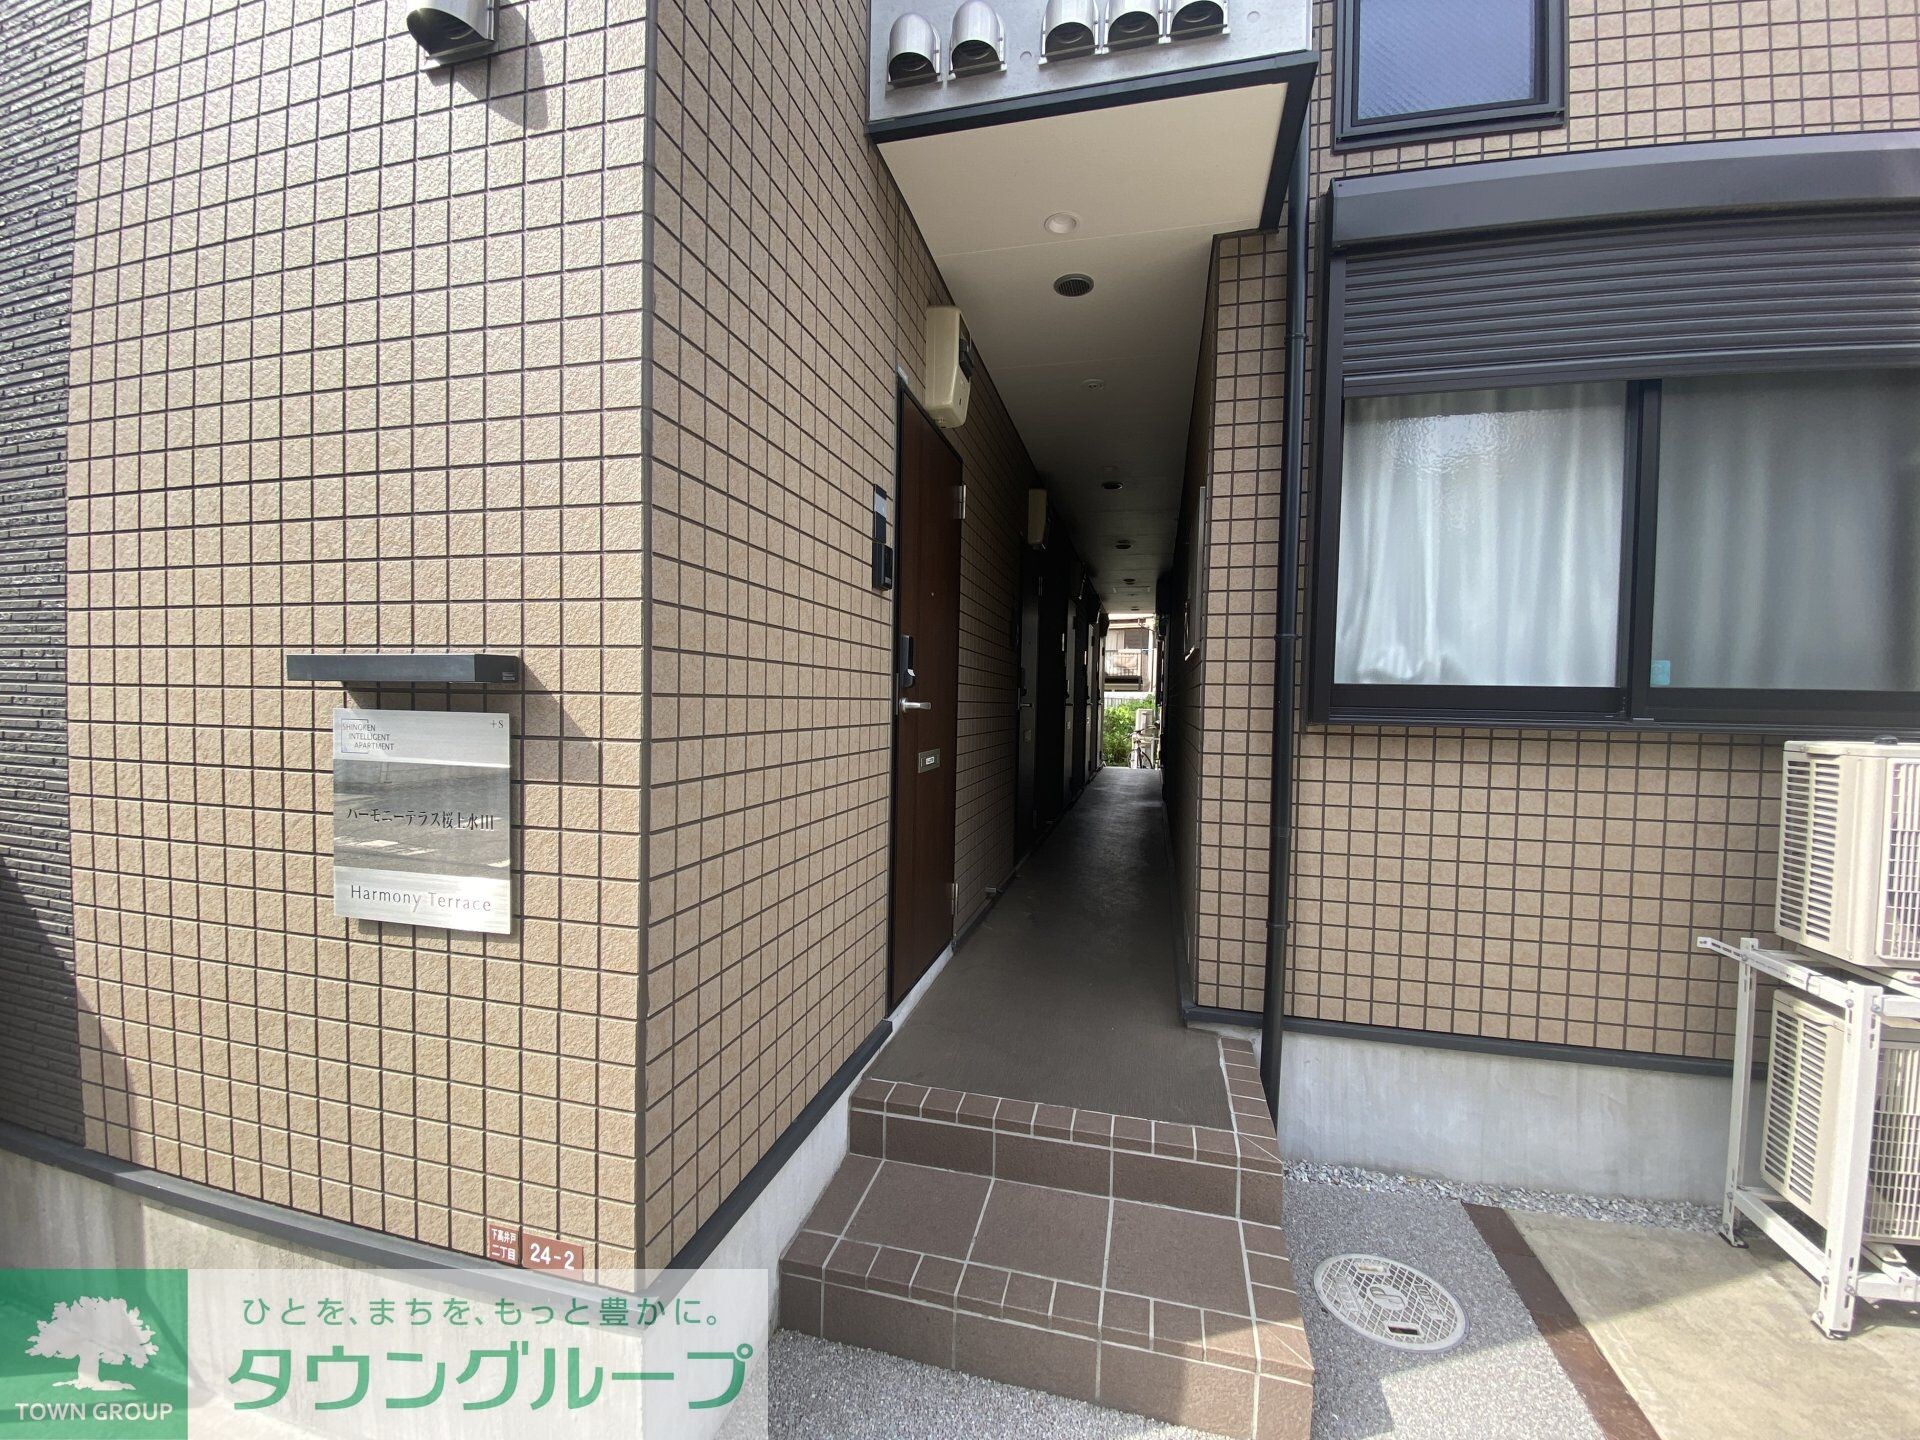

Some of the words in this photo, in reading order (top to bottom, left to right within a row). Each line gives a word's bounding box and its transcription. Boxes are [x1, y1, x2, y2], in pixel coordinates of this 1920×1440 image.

[349, 732, 390, 742] INTELLIGENT
[354, 742, 395, 751] APARTMENT
[350, 885, 422, 912] Harmony
[428, 892, 491, 911] Terrace
[491, 1227, 517, 1245] 下高井戸
[530, 1242, 575, 1271] 24-2
